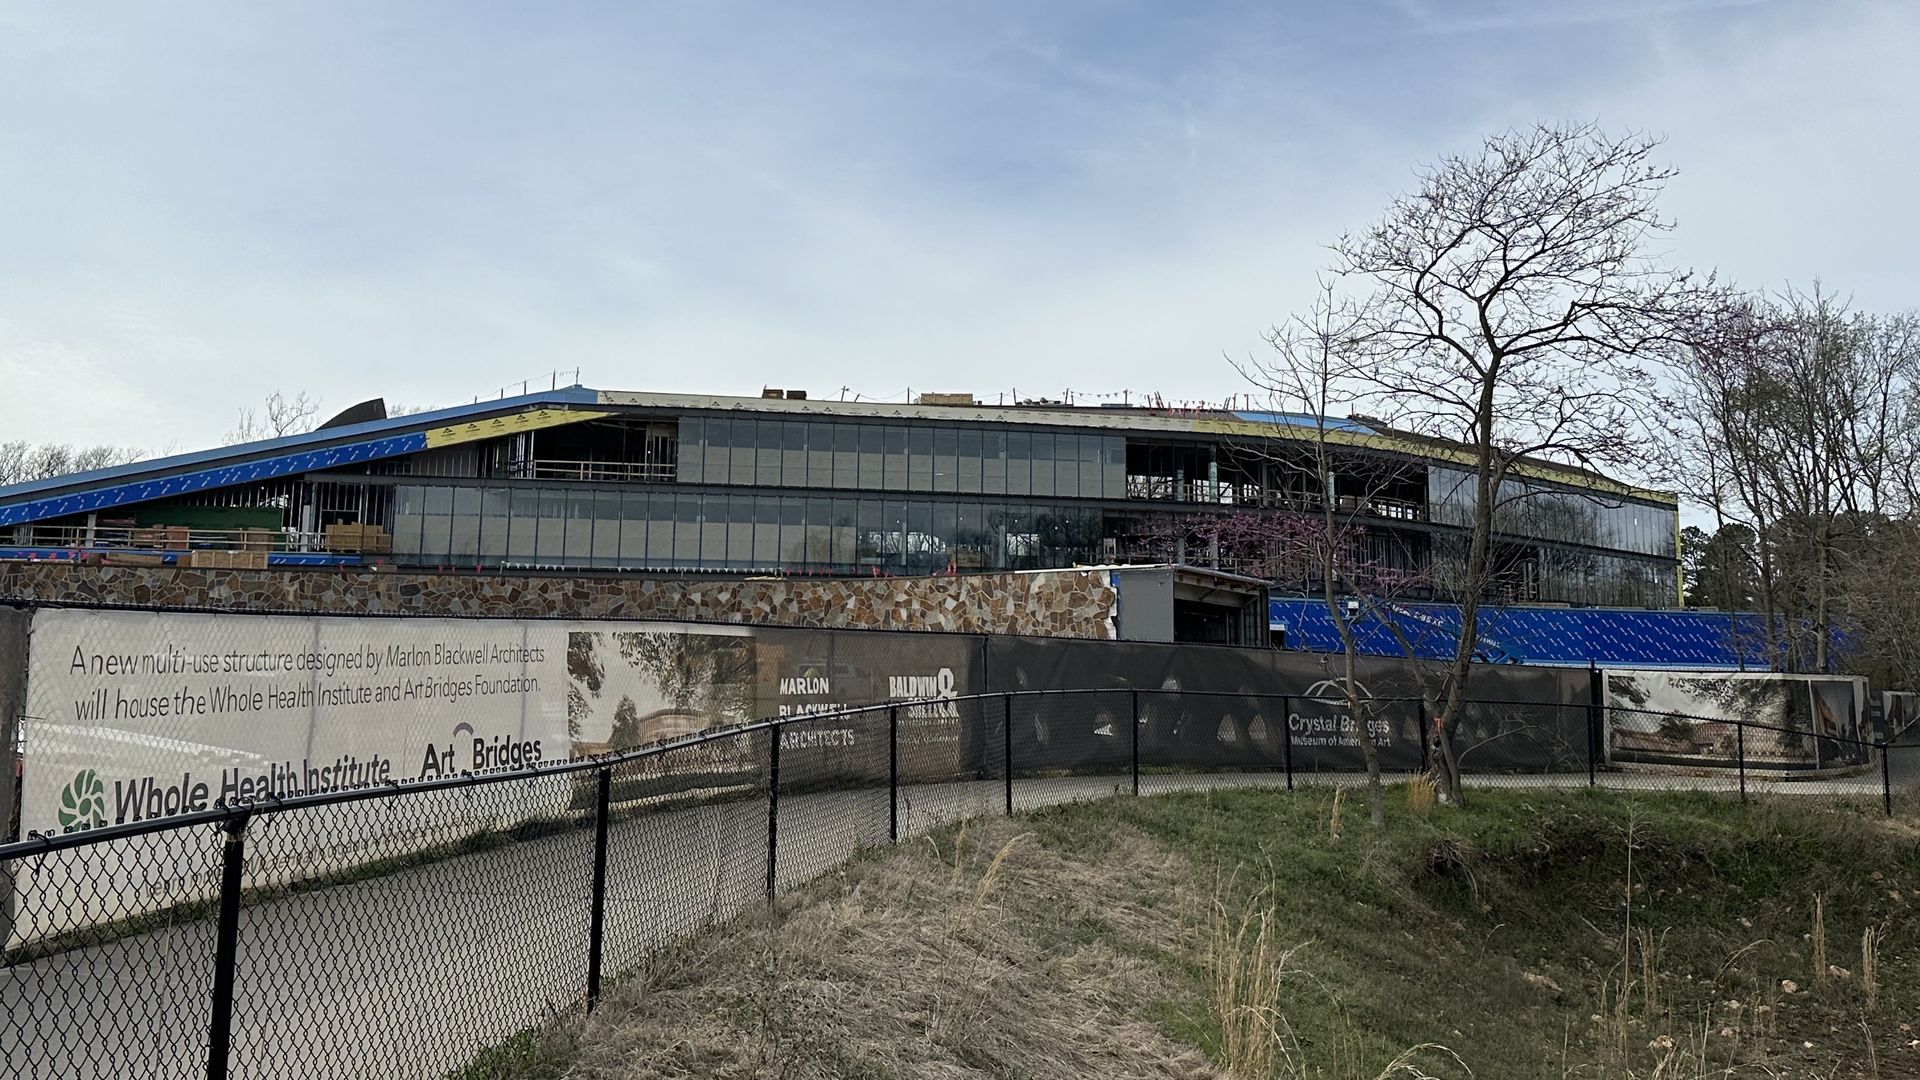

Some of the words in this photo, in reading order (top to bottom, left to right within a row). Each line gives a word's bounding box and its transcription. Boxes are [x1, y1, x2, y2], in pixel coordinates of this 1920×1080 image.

[70, 645, 87, 675] A
[91, 653, 138, 675] new
[142, 644, 219, 674] multi-use
[223, 649, 293, 673] structure
[297, 644, 362, 677] designed
[366, 645, 383, 675] by
[386, 643, 431, 668] Marlon
[434, 643, 488, 665] Blackwell
[490, 642, 545, 664] Architects
[75, 688, 107, 720] will
[115, 688, 169, 719] house
[174, 686, 206, 715] the
[209, 684, 263, 713] Whole
[268, 681, 314, 709] Health
[318, 681, 372, 707] Institute
[375, 678, 401, 702] and
[404, 678, 424, 700] Art
[426, 676, 472, 703] Bridges
[475, 672, 541, 695] Foundation.
[779, 677, 830, 695] MARLON
[889, 676, 937, 698] BALDWIN
[1288, 713, 1337, 735] Crystal
[1340, 715, 1390, 738] Brges
[779, 729, 855, 749] ARCHITECTS
[1290, 736, 1326, 746] Museum
[1328, 735, 1337, 746] of
[1338, 736, 1376, 747] Amerin
[1377, 737, 1391, 747] Art
[421, 743, 455, 777] Art
[473, 735, 542, 771] Bridges
[115, 772, 209, 820] Whole
[221, 762, 297, 805] Health
[303, 754, 391, 795] Institute
